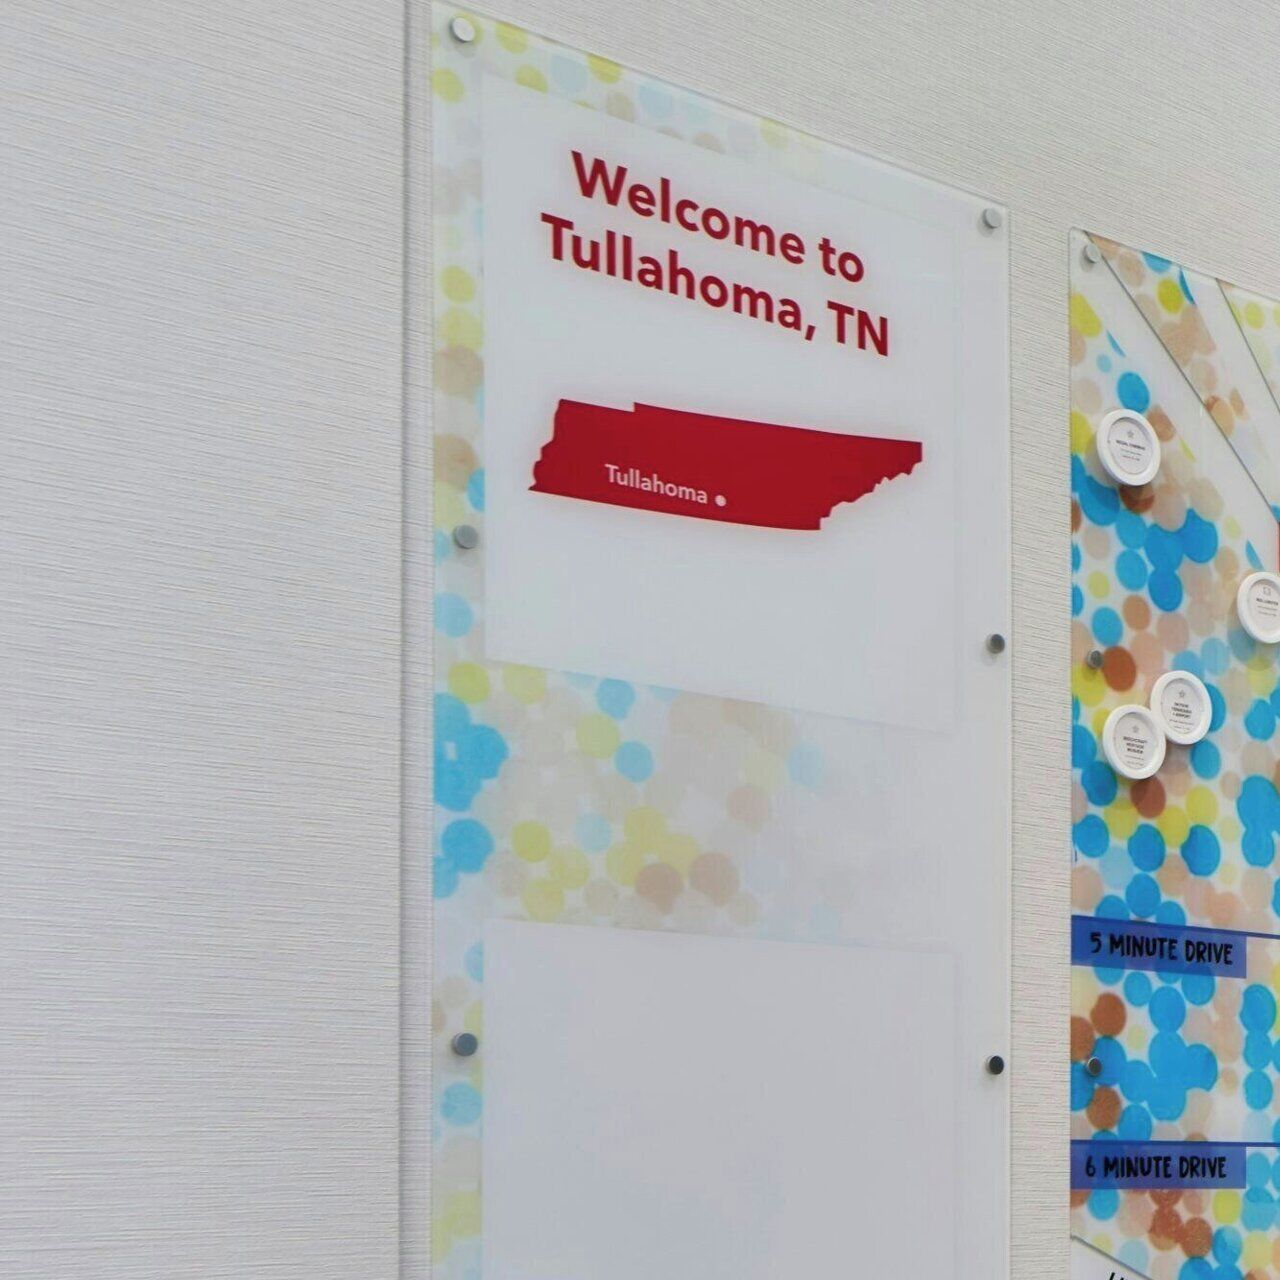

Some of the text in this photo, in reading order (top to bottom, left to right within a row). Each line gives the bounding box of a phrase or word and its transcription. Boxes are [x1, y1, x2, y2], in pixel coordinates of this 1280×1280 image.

[571, 150, 865, 283] Welcome to
[541, 212, 888, 357] Tullahoma, TN
[605, 464, 708, 505] Tullahoma
[1090, 932, 1233, 965] 5 MINUTE DRIVE
[1085, 1156, 1227, 1179] 6 MINUTE DRIVE
